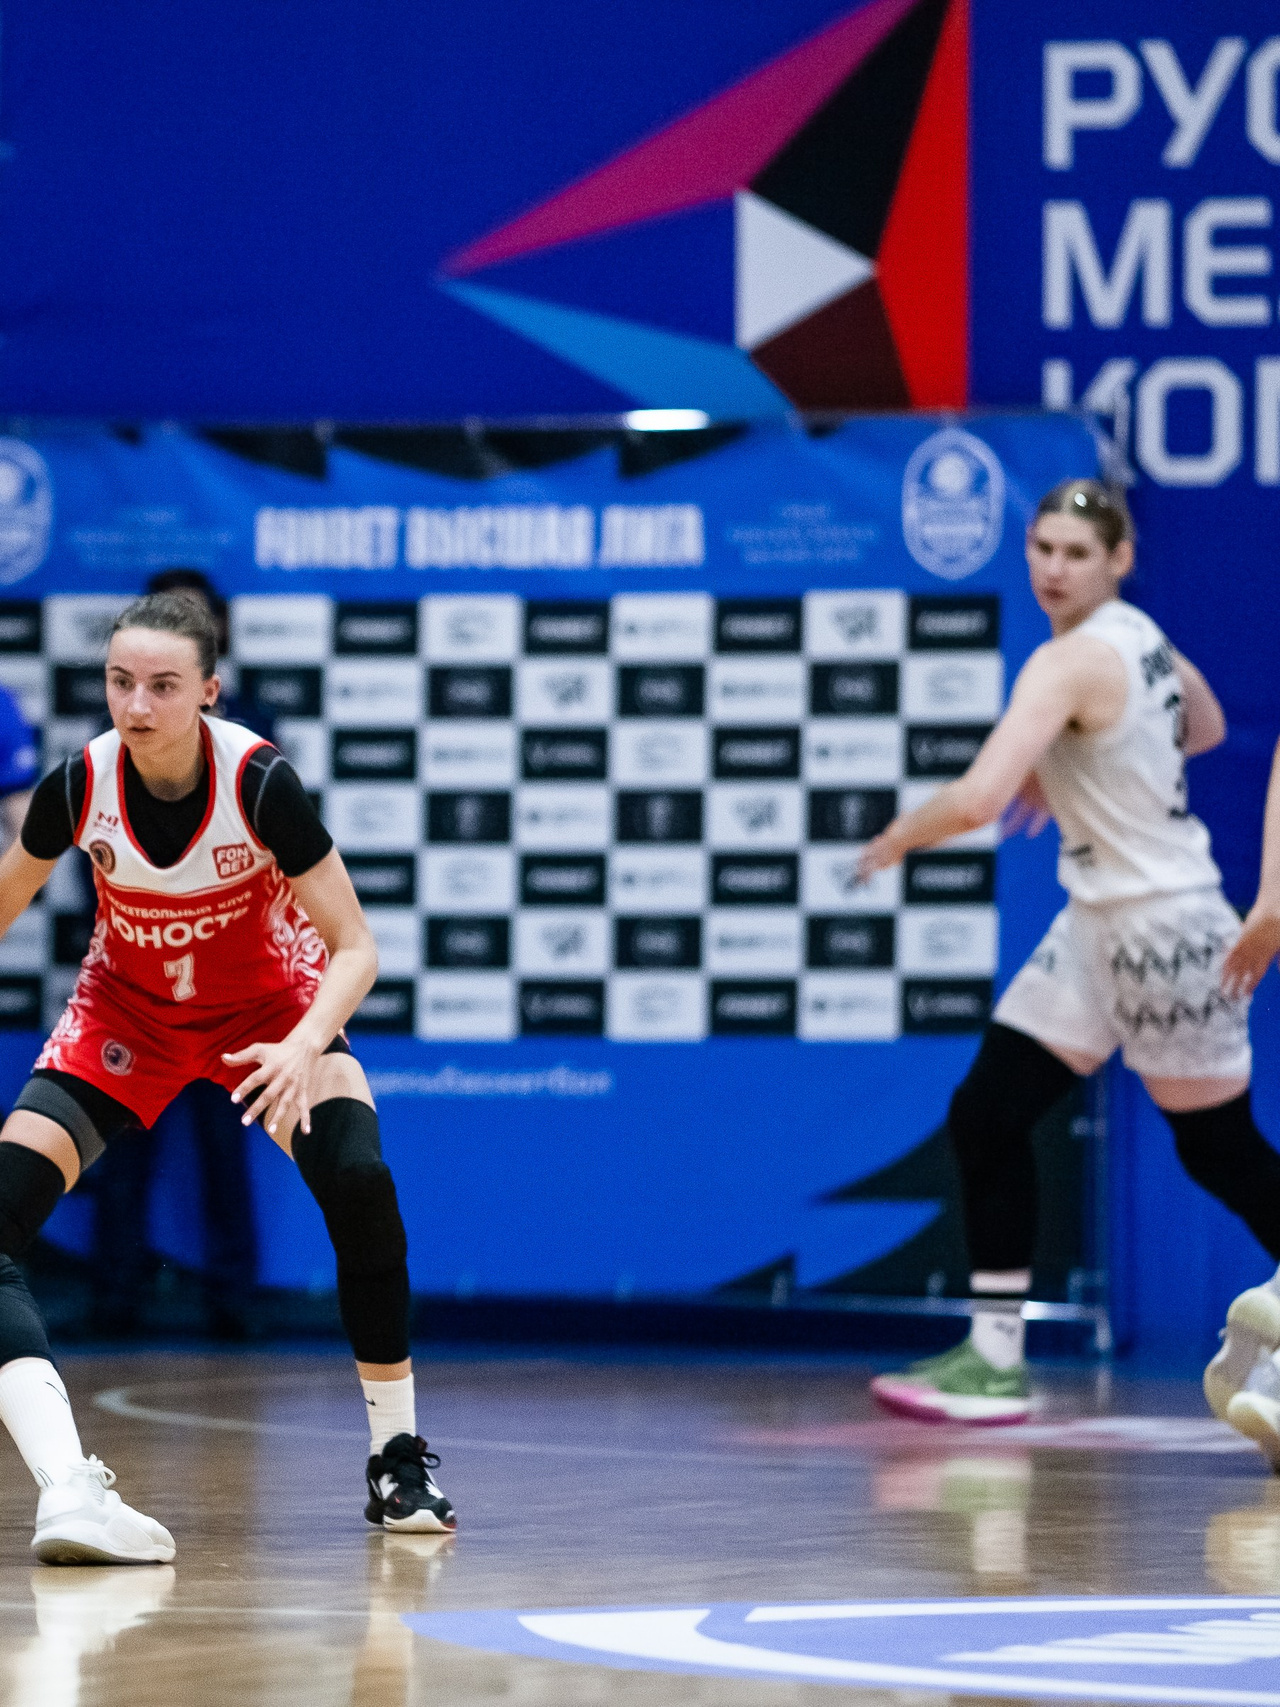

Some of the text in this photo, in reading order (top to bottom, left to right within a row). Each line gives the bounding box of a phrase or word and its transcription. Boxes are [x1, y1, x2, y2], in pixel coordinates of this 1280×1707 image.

[1042, 197, 1280, 330] МЕ
[216, 847, 249, 864] FON
[220, 857, 250, 876] BET
[163, 951, 197, 1002] 7
